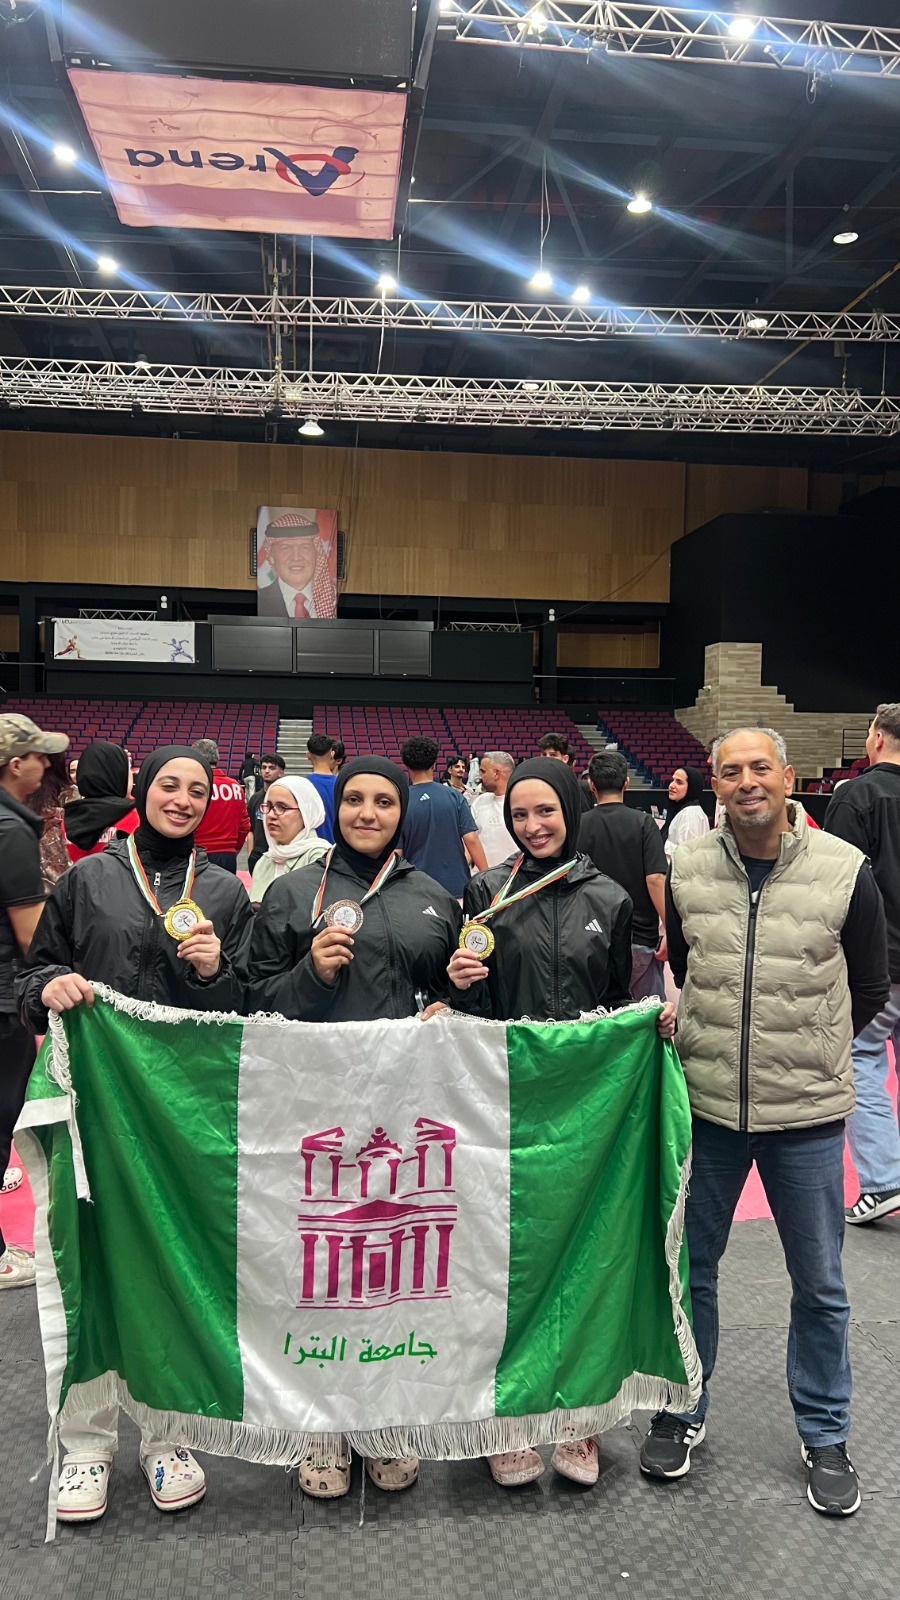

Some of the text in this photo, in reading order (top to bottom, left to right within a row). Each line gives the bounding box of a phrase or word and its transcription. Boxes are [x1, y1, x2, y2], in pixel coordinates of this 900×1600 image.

[123, 145, 360, 197] Arena
[211, 783, 242, 801] JOR
[283, 1330, 438, 1369] جامعة البترا
